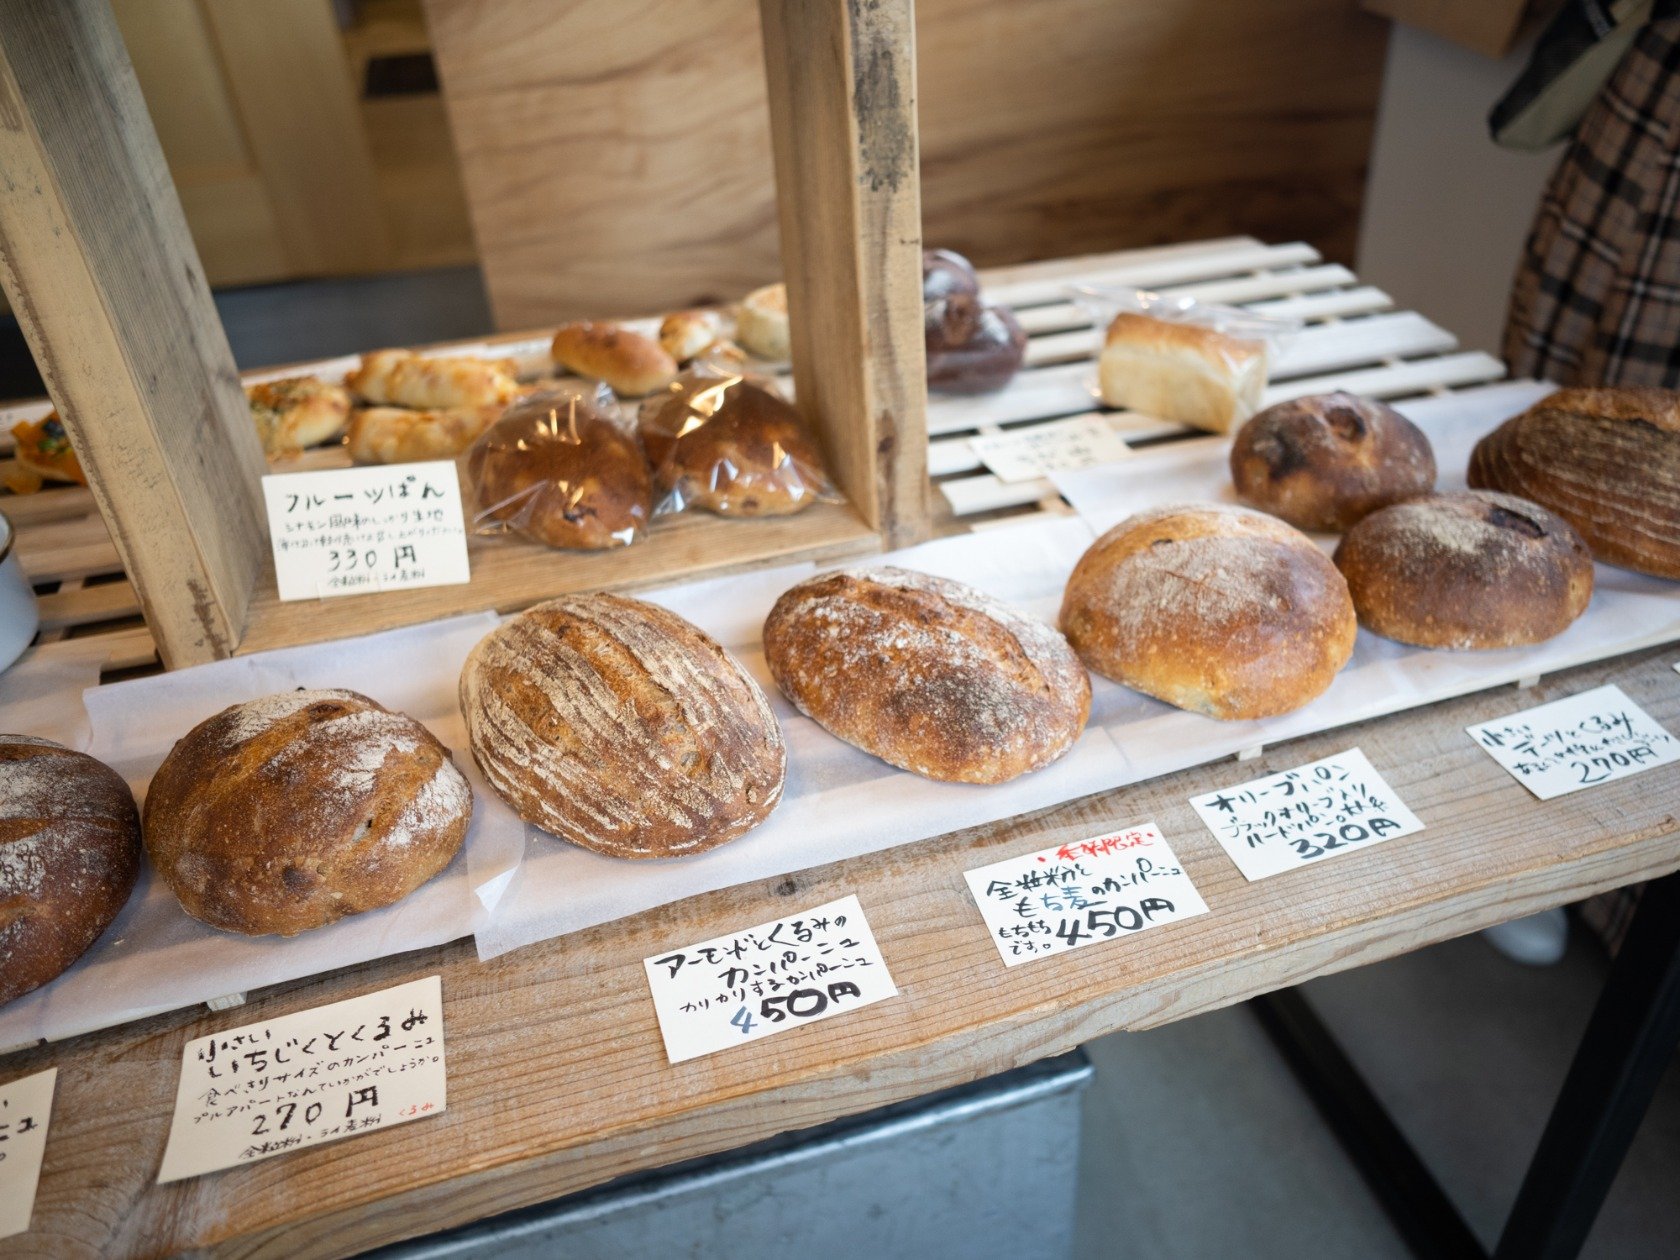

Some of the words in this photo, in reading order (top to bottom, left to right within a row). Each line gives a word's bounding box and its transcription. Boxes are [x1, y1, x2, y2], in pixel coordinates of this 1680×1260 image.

[330, 545, 417, 572] 330円
[1571, 743, 1657, 783] 270円
[1205, 766, 1348, 813] オリーブパン
[1289, 818, 1401, 859] 320円
[999, 920, 1051, 938] もちもち
[1009, 936, 1051, 955] です。
[1056, 898, 1175, 946] 450円
[680, 957, 873, 1013] カリカリするカンパーニュ
[718, 938, 859, 988] カンパーニュ
[730, 981, 861, 1034] 450円
[198, 1030, 270, 1063] 小さい
[208, 1009, 428, 1078] いちじくとくるみ
[197, 1037, 434, 1107] 食べきりサイズのカンパーニュ
[252, 1086, 378, 1135] 270円
[399, 1103, 434, 1116] くるみ
